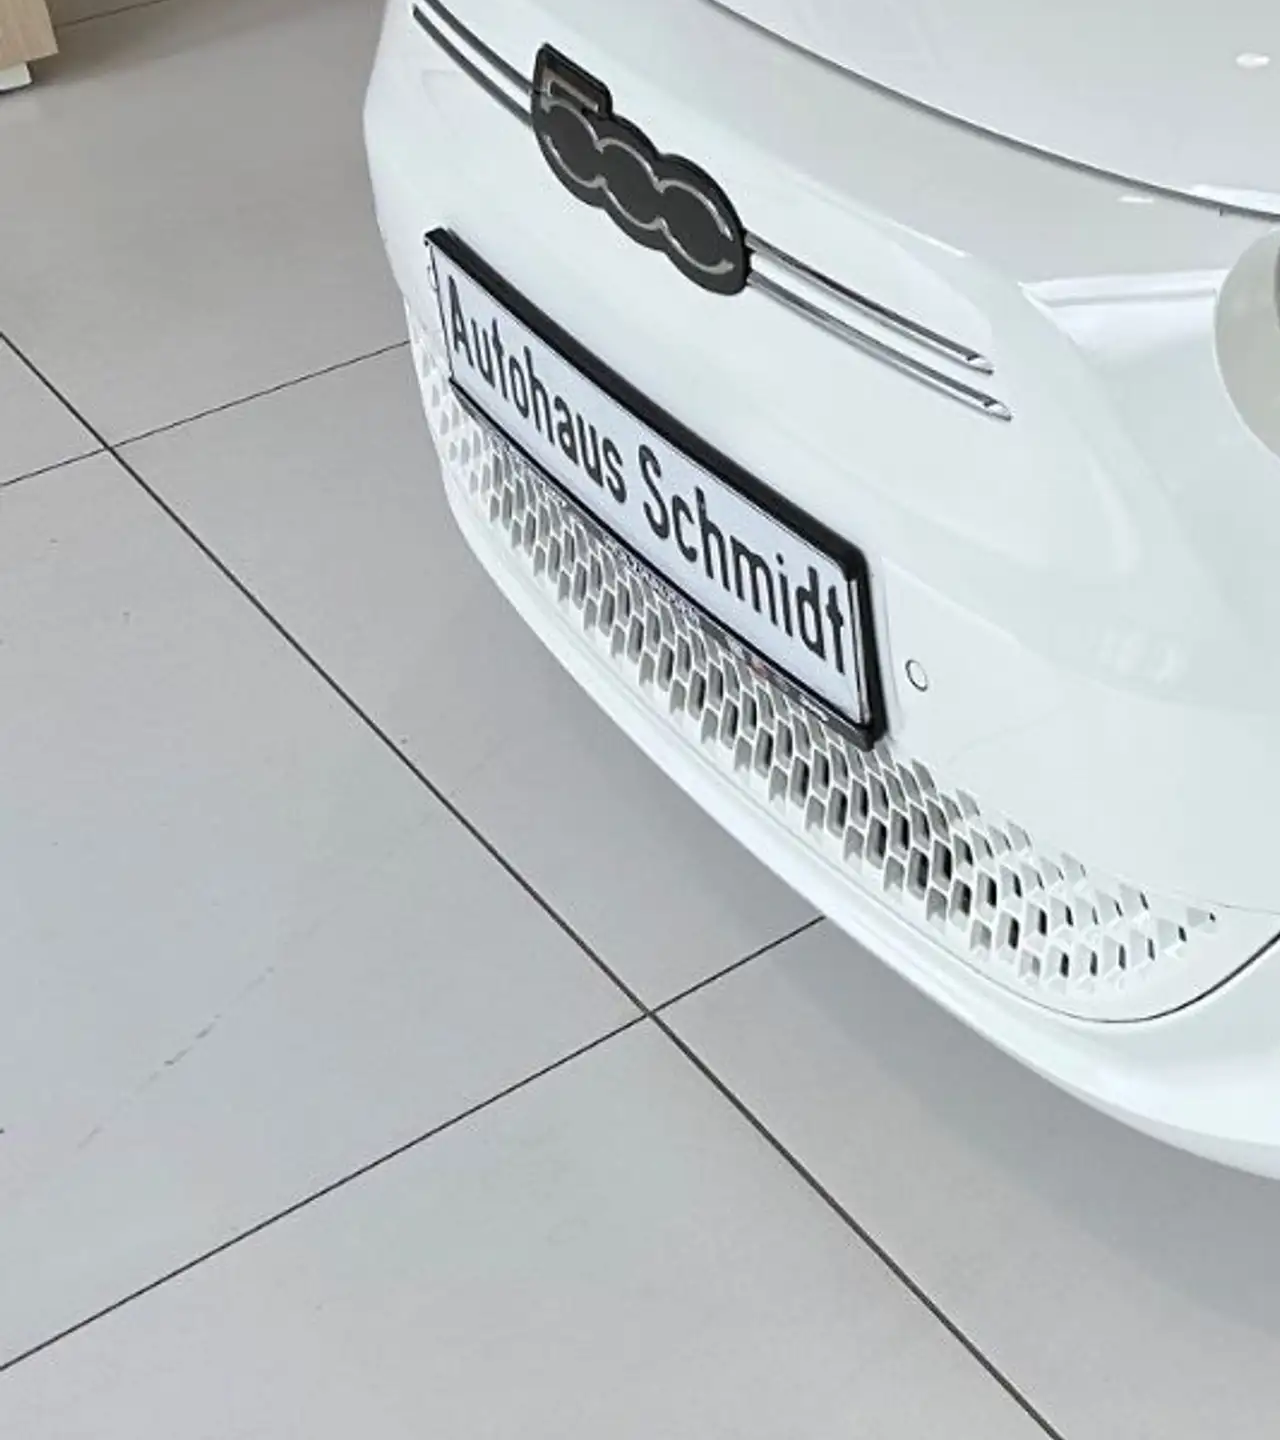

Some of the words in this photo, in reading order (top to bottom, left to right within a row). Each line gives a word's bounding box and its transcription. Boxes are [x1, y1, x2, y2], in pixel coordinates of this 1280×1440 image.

[532, 44, 748, 294] 500
[449, 276, 627, 503] Autohaus
[639, 444, 847, 675] Schmidt
